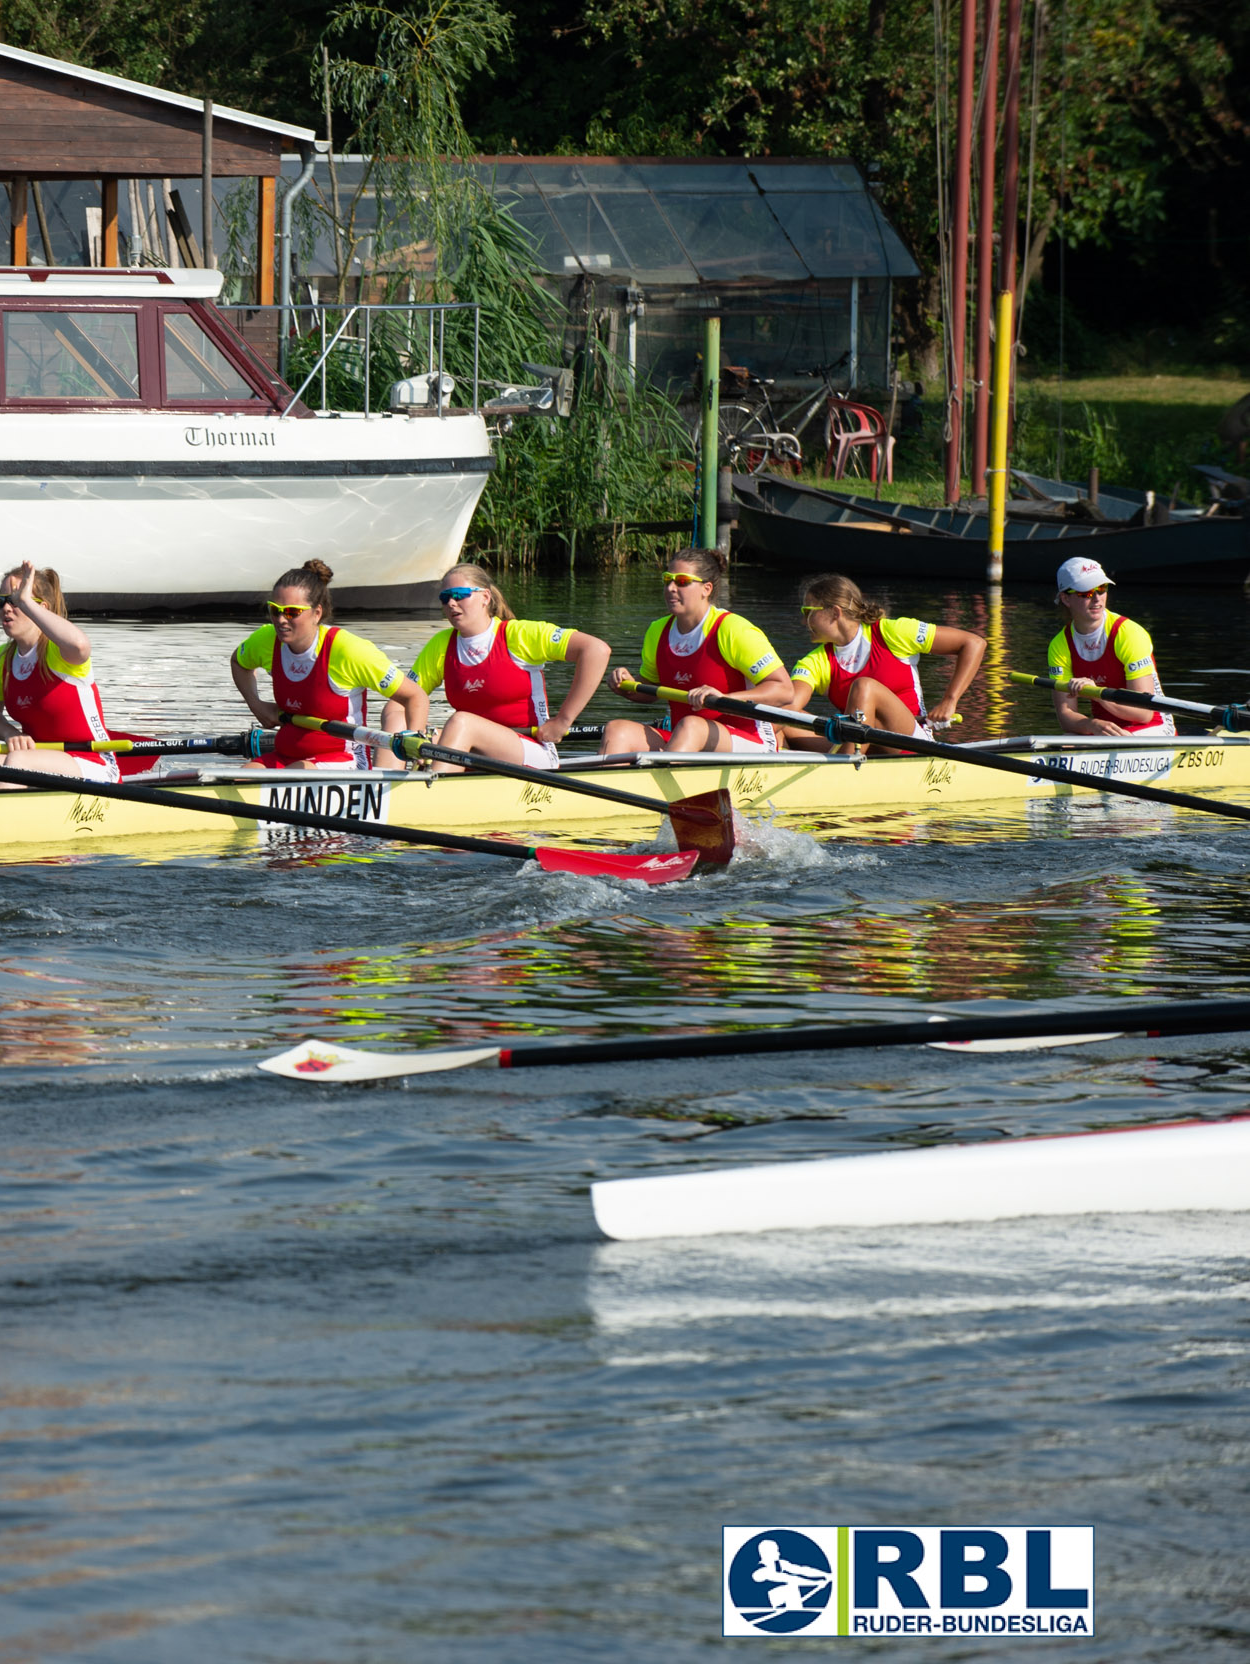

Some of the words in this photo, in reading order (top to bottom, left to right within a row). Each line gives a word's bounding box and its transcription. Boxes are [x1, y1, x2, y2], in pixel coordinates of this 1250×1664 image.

[1080, 757, 1169, 775] RUDER-BUNDESLIGA
[1178, 753, 1188, 768] Z
[1188, 752, 1202, 768] BS
[1205, 750, 1224, 766] 001
[268, 783, 382, 820] MINDEN
